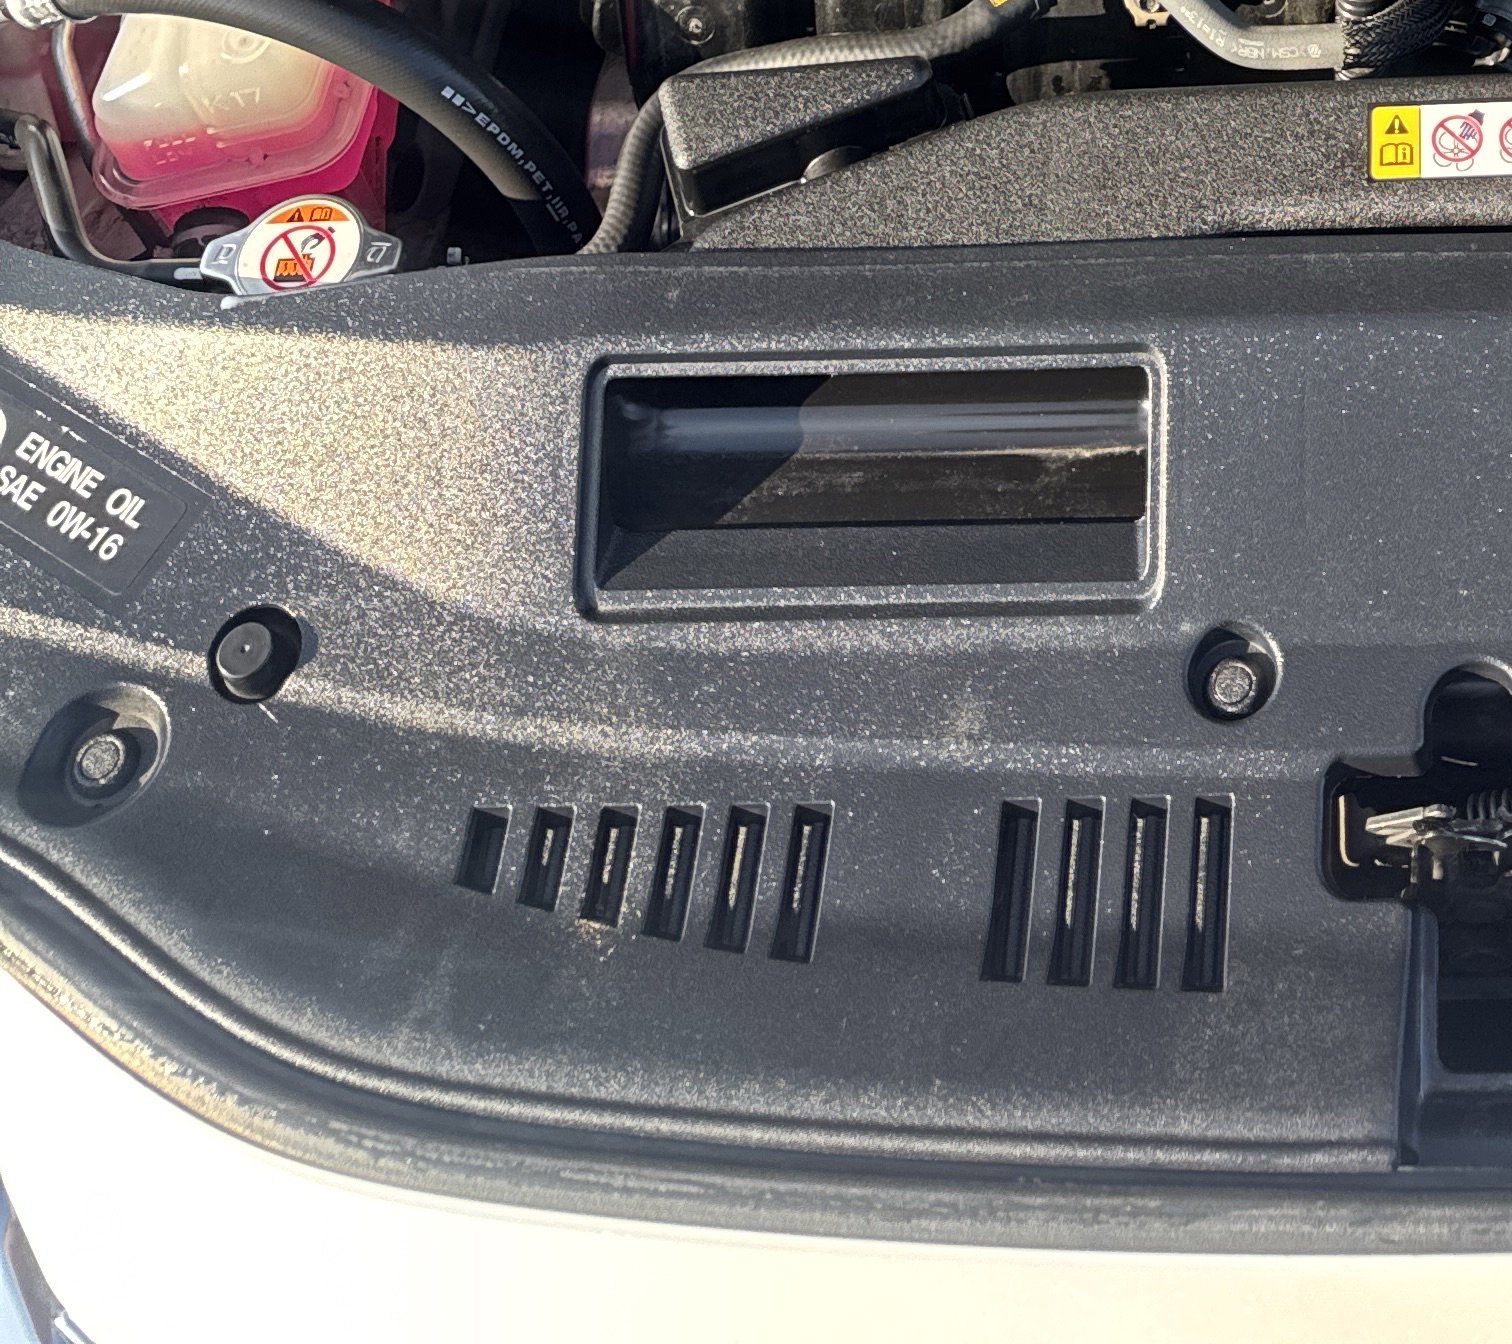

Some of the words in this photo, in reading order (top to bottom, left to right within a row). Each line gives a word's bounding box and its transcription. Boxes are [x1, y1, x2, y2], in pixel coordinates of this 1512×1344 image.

[0, 465, 47, 512] SAE
[46, 500, 125, 561] 0W-16
[15, 431, 106, 499] ENGINE
[105, 487, 146, 530] OIL
